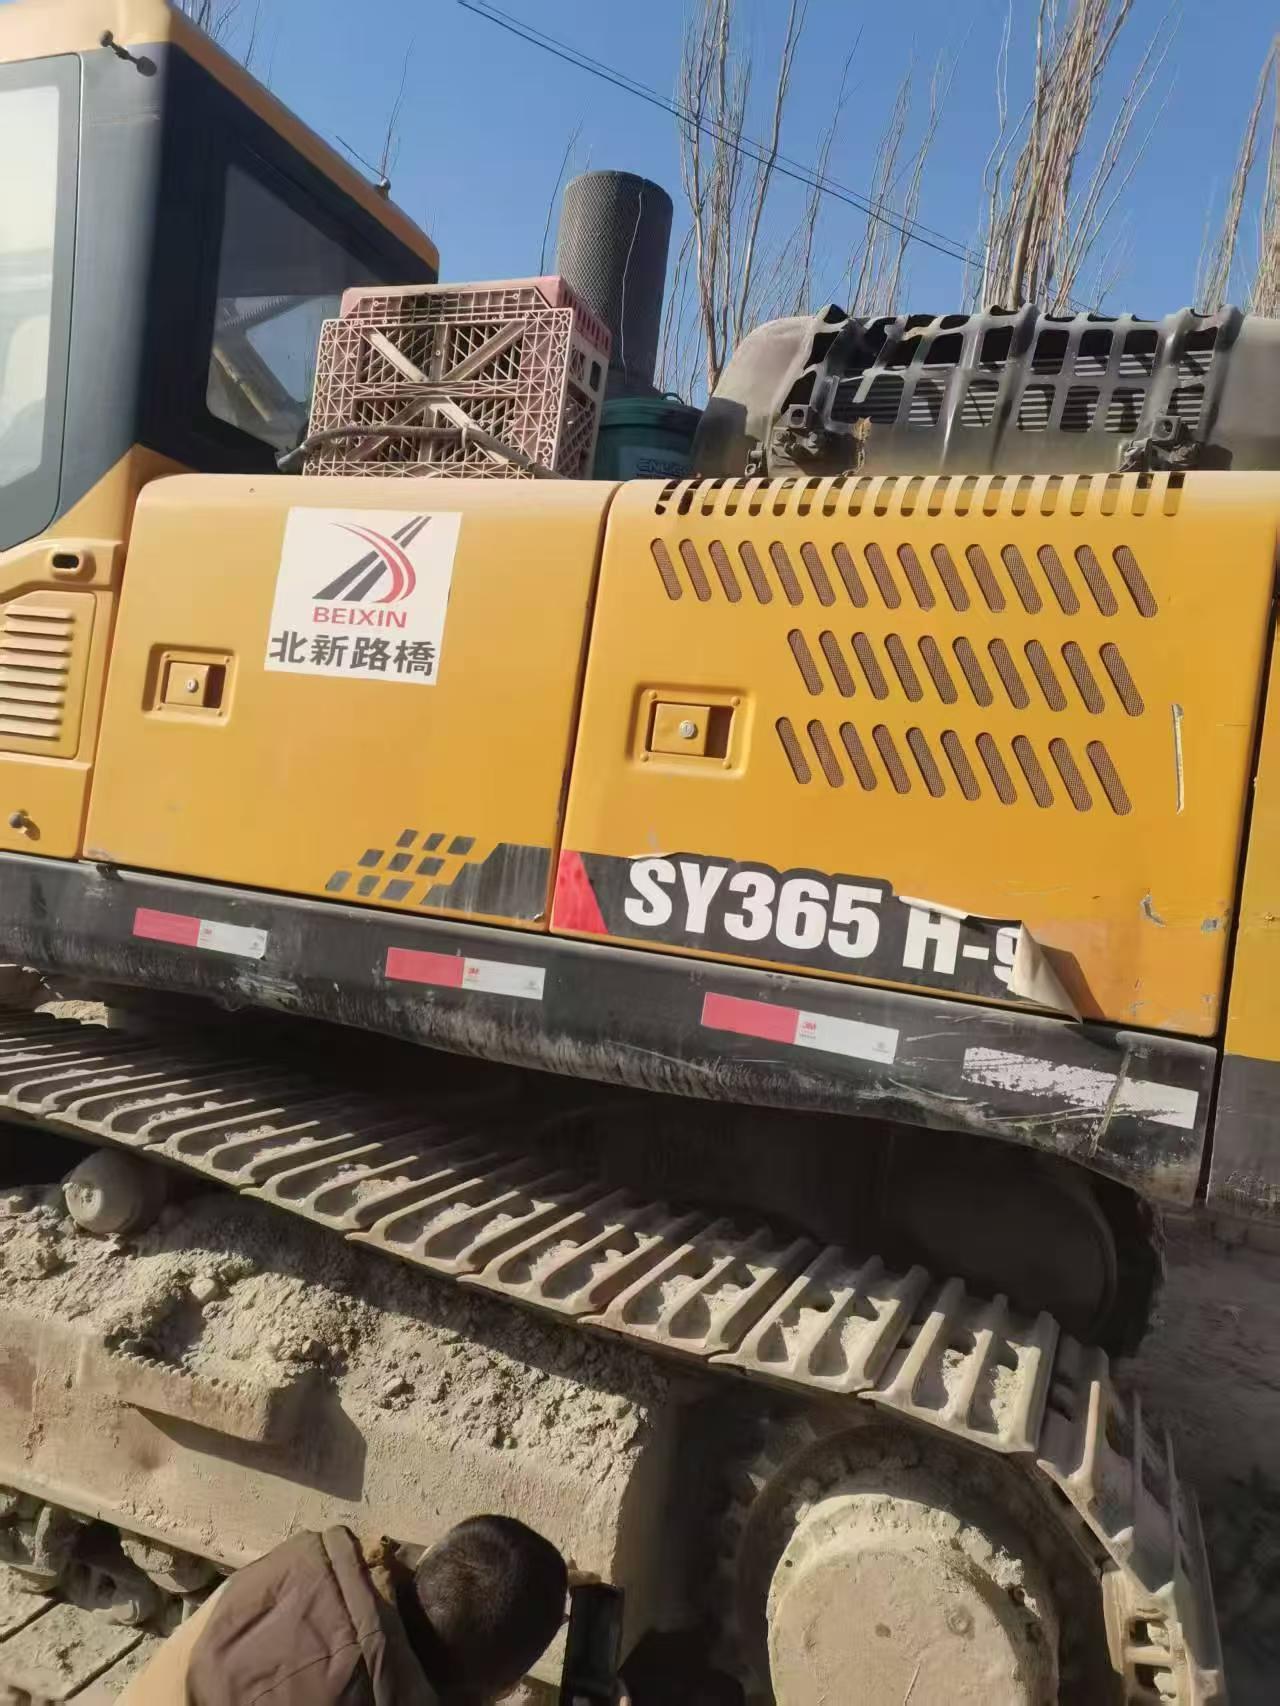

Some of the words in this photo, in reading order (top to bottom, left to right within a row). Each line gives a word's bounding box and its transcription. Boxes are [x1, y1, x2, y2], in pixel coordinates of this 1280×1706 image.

[312, 606, 408, 628] BEIXIN
[269, 630, 436, 676] 北新路橋
[624, 858, 883, 959] SY365
